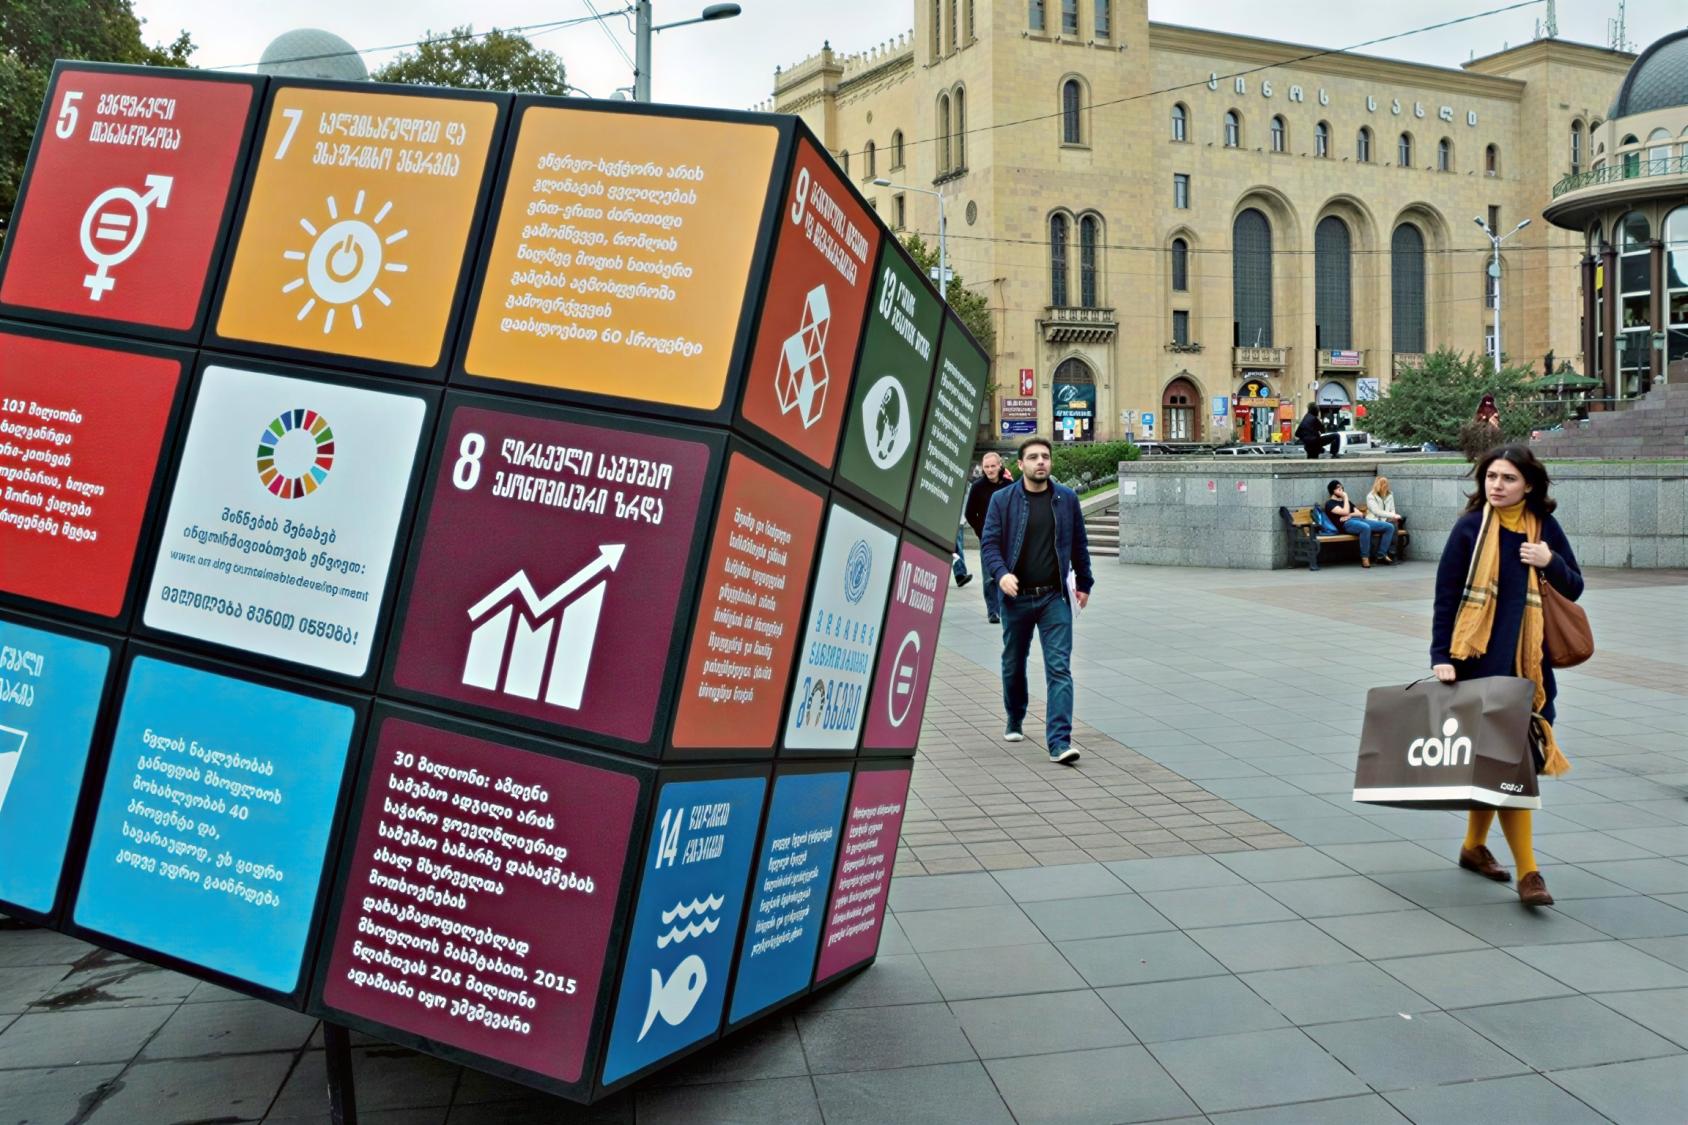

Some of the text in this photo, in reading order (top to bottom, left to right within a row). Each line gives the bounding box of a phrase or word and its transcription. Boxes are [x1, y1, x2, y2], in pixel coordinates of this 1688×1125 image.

[55, 90, 83, 140] 5
[274, 108, 304, 160] 7
[445, 121, 467, 146] და
[666, 164, 705, 182] არის
[791, 166, 810, 225] 9
[878, 266, 897, 321] 13
[600, 327, 623, 345] 60
[452, 432, 486, 491] 8
[499, 437, 673, 490] ღირსეული სამუშაო
[492, 470, 664, 526] ეკონომიკური ზრდა
[1407, 717, 1473, 768] coin
[204, 769, 283, 805] მსოფლიოს
[388, 771, 555, 830] სამუშაო ადგილი არის
[393, 750, 549, 803] 30 მილიონი: ამდენი
[228, 804, 250, 821] 40
[383, 796, 439, 826] საჭირო
[215, 850, 233, 868] ეს
[373, 845, 413, 872] ახალ
[654, 807, 685, 870] 14
[159, 860, 201, 883] უფრო
[357, 915, 440, 954] მსოფლიოს
[532, 968, 577, 995] 2015
[347, 967, 415, 999] ადამიანი
[417, 989, 447, 1009] იყო
[465, 973, 536, 1009] მილიონი
